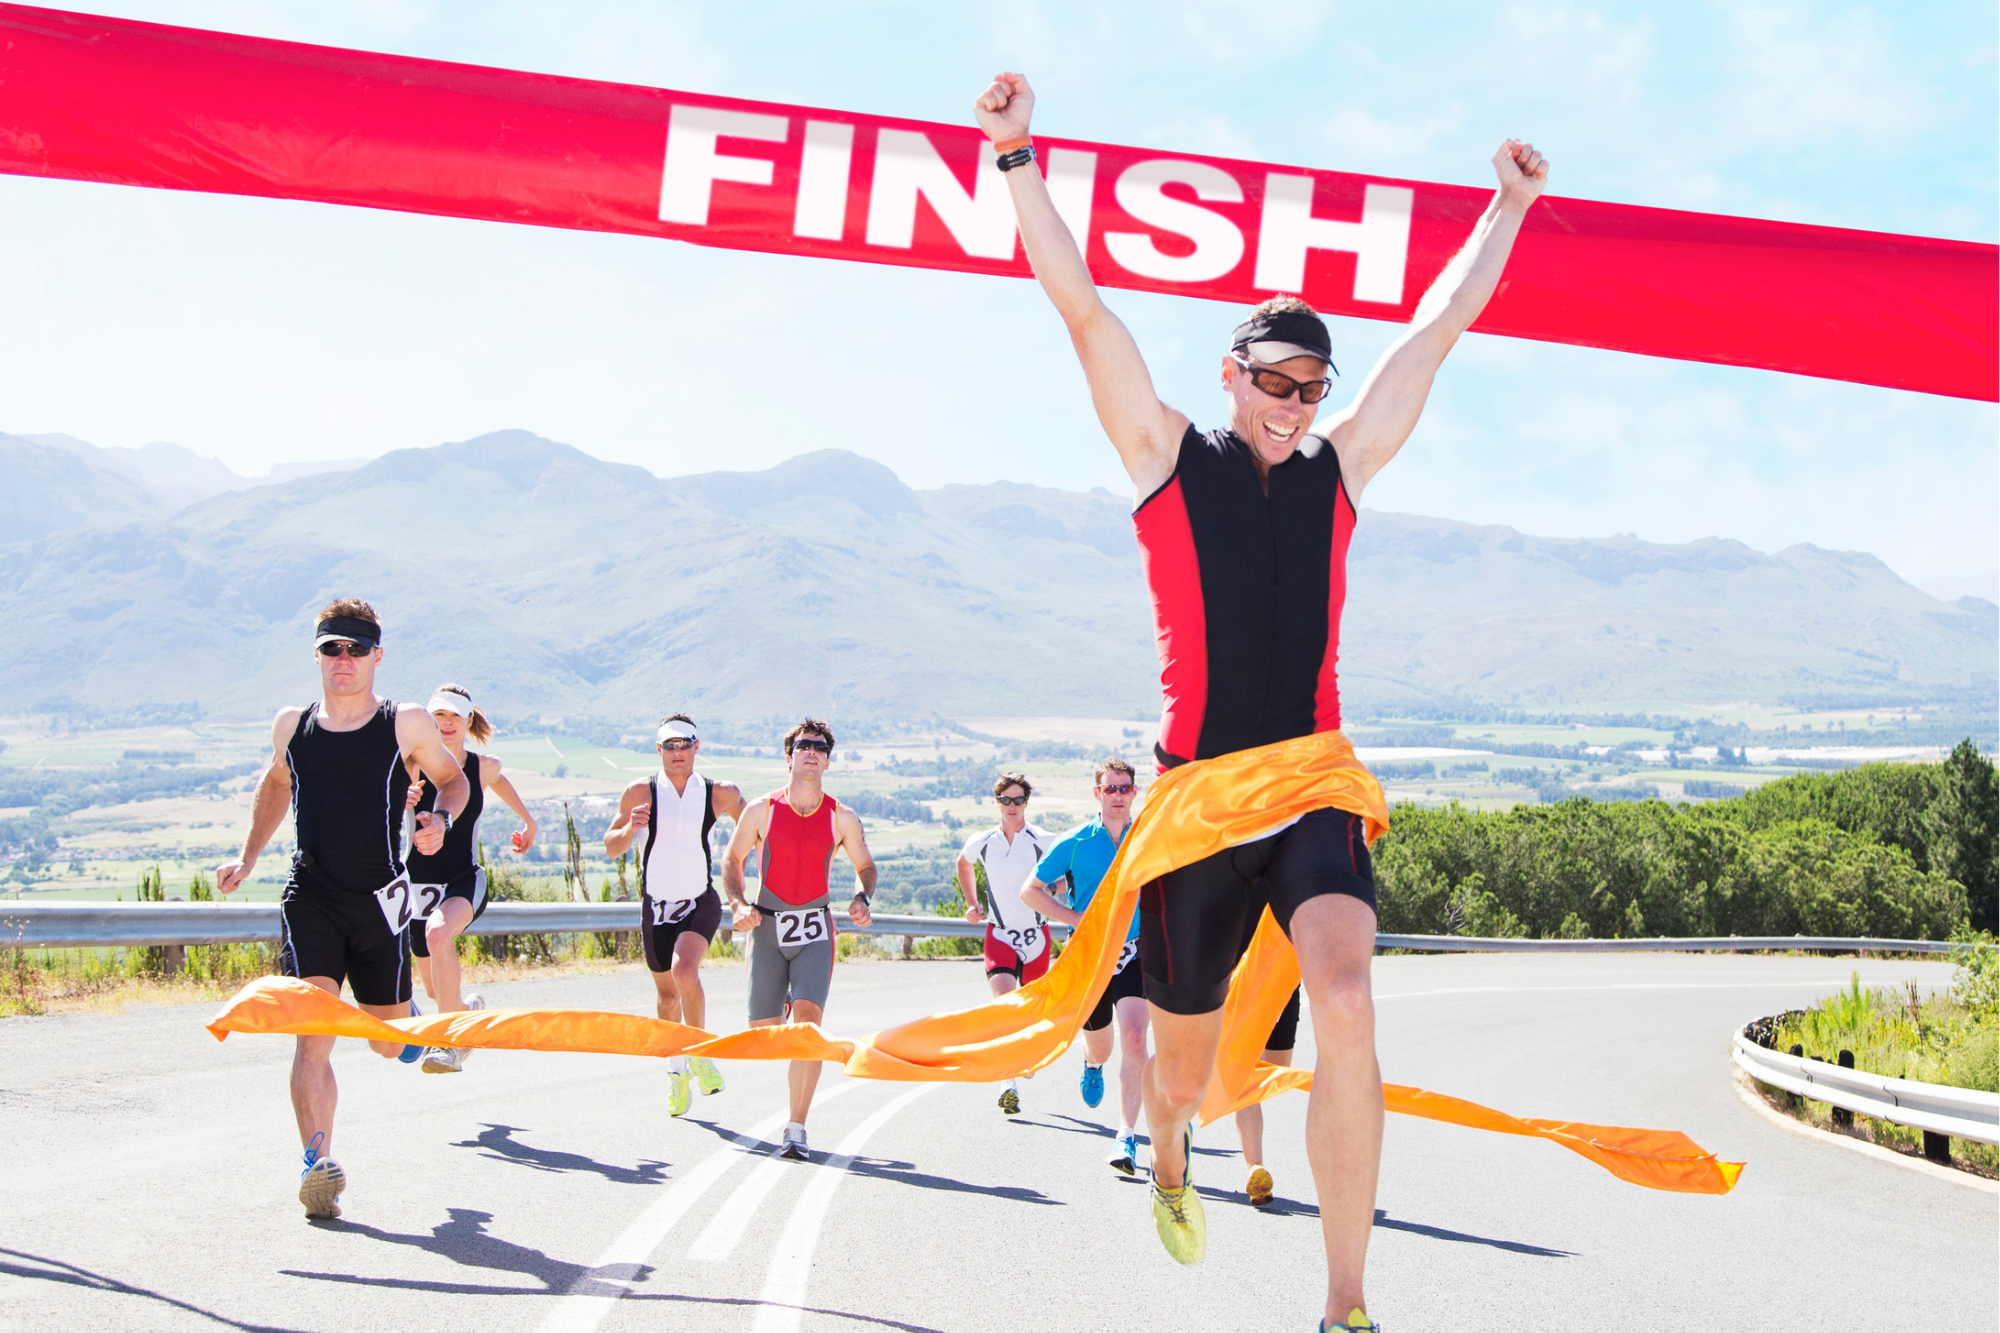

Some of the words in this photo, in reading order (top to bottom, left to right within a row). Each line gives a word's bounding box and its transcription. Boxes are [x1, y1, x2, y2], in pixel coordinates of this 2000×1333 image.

[658, 104, 1414, 305] FINISH
[654, 899, 691, 922] 12
[781, 912, 822, 943] 25
[1007, 928, 1037, 948] 28
